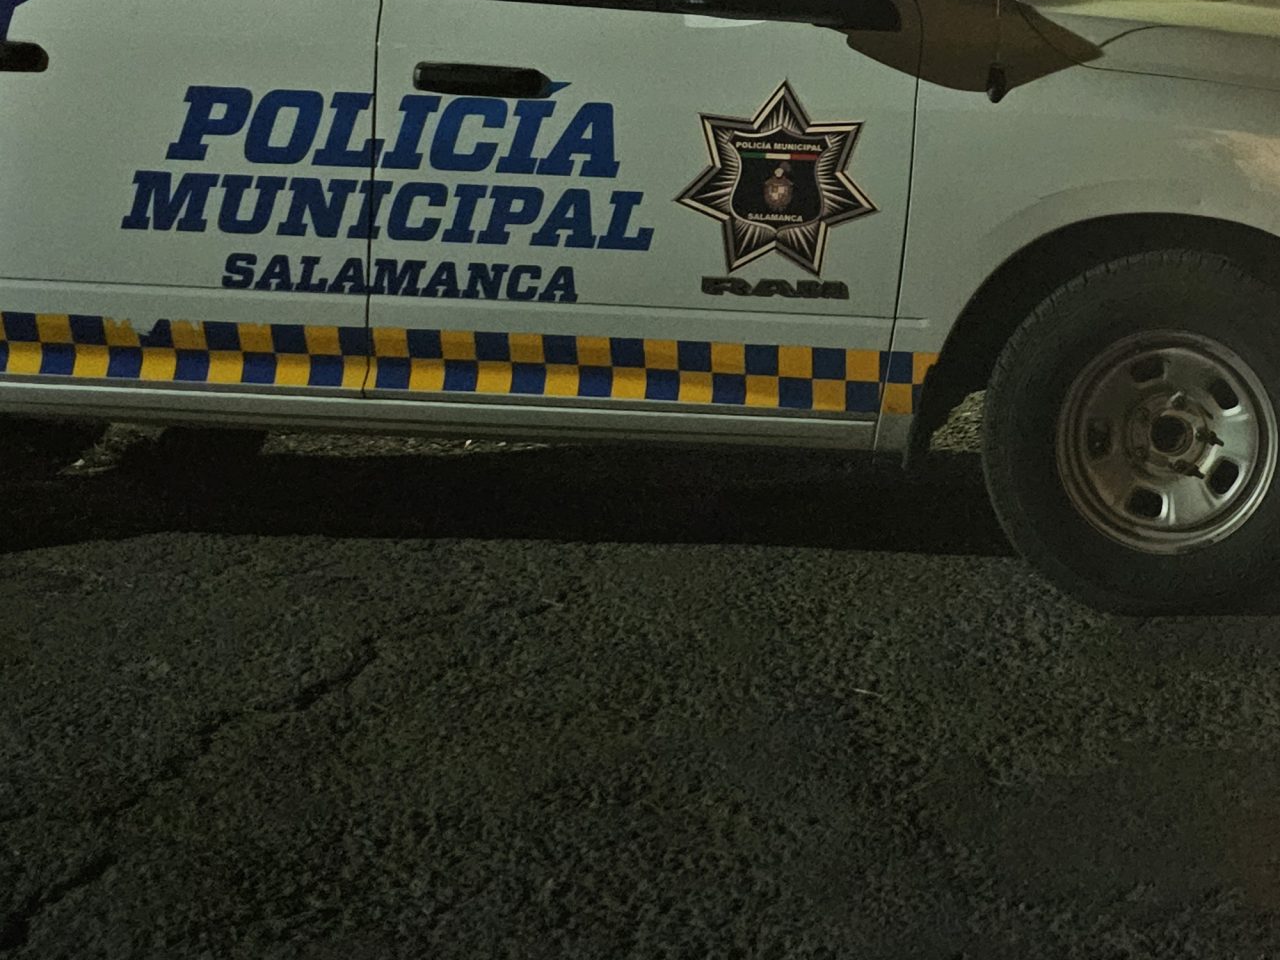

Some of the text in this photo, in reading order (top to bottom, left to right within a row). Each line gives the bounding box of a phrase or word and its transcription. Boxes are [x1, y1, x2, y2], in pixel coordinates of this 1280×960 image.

[773, 143, 823, 152] MUNICIPAL
[121, 170, 655, 251] MUNICIPAL
[747, 212, 804, 223] SALAMANCA
[221, 252, 579, 303] SALAMANCA
[701, 276, 850, 300] RAM
